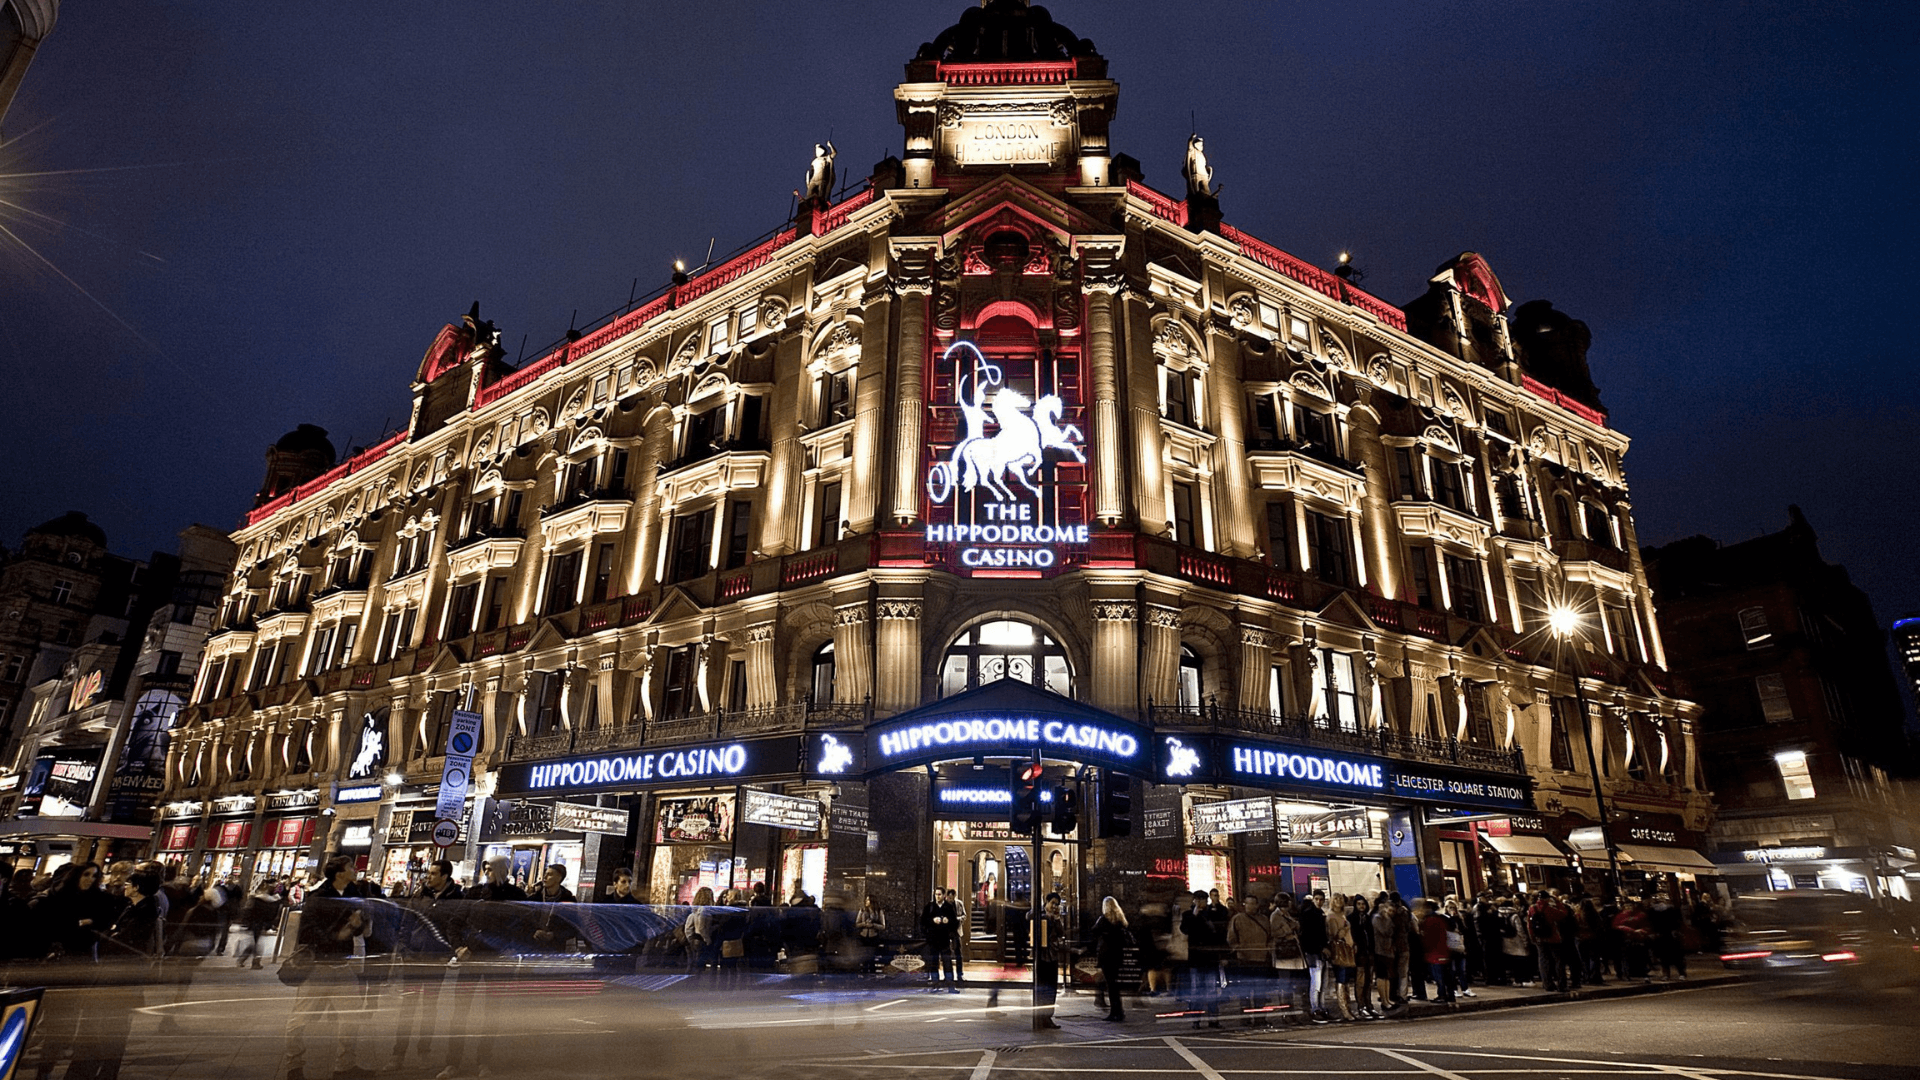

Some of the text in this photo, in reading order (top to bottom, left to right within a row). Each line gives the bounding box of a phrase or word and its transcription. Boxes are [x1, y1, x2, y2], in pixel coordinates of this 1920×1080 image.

[975, 123, 1039, 139] LONDON
[955, 142, 1060, 161] HODROME
[984, 503, 1031, 521] THE
[926, 524, 1090, 543] HIPPODROME
[961, 548, 1054, 567] CASINO
[454, 711, 482, 720] Restricted
[456, 718, 477, 726] parking
[455, 723, 475, 732] ZONE
[879, 719, 1138, 757] HIPPODROME CASINO
[66, 764, 96, 781] SPARKS
[529, 744, 746, 788] HIPPODROME CASINO
[1232, 747, 1383, 788] HIPPODROME
[1396, 774, 1523, 800] LEICESTER SQUARE STATION
[940, 789, 1012, 802] HIPPODRO
[799, 803, 817, 812] WITH
[392, 813, 411, 826] HALF
[560, 808, 590, 819] FORTY
[591, 811, 625, 823] GAMING
[1201, 812, 1228, 824] TEXAS
[573, 819, 608, 830] TABLES
[970, 821, 984, 829] NO
[1219, 820, 1247, 831] POKER
[1293, 817, 1364, 835] FIVE BARS
[1511, 817, 1543, 830] ROUGE
[390, 826, 410, 838] PRICE
[970, 830, 994, 838] FREE
[996, 830, 1009, 838] TO
[1651, 830, 1677, 842] ROUGE
